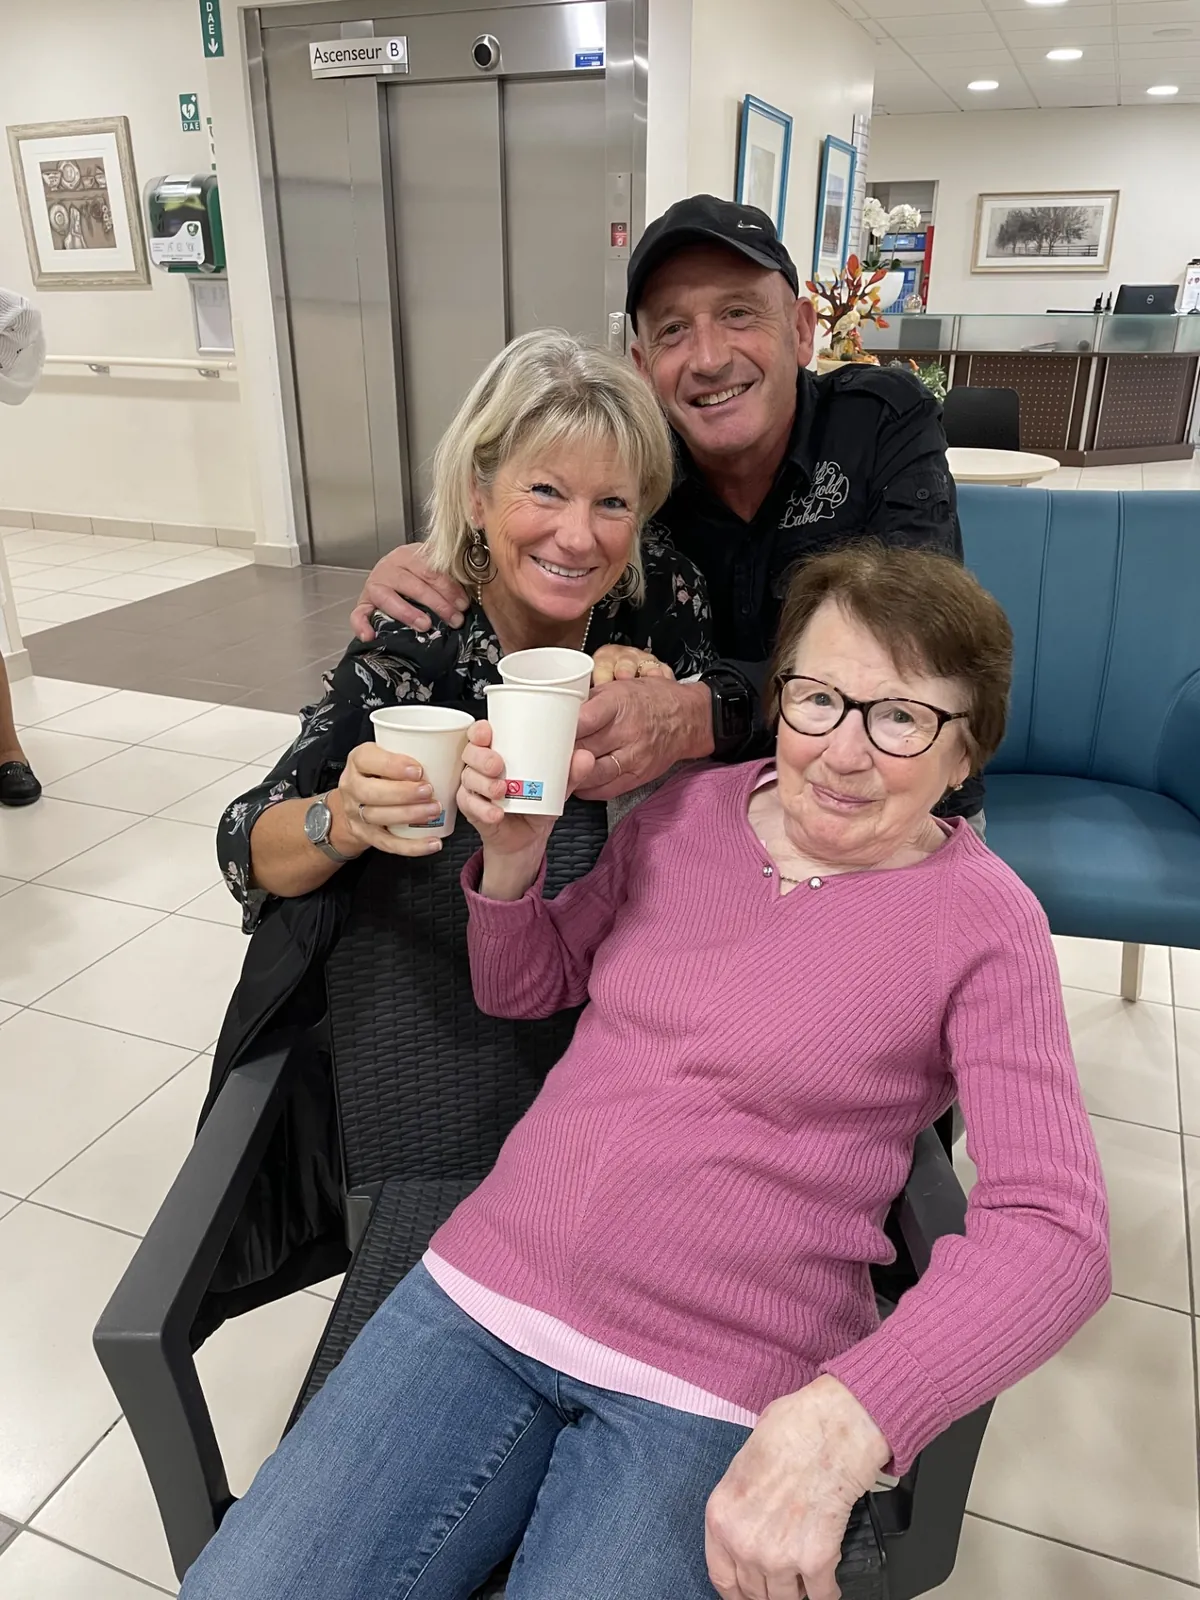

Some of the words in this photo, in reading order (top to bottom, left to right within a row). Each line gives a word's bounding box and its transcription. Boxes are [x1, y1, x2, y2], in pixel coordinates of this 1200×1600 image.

[206, 2, 215, 34] DAE
[313, 47, 382, 64] Ascenseur
[390, 42, 399, 57] B
[183, 122, 200, 131] DAE
[778, 501, 835, 529] Label
